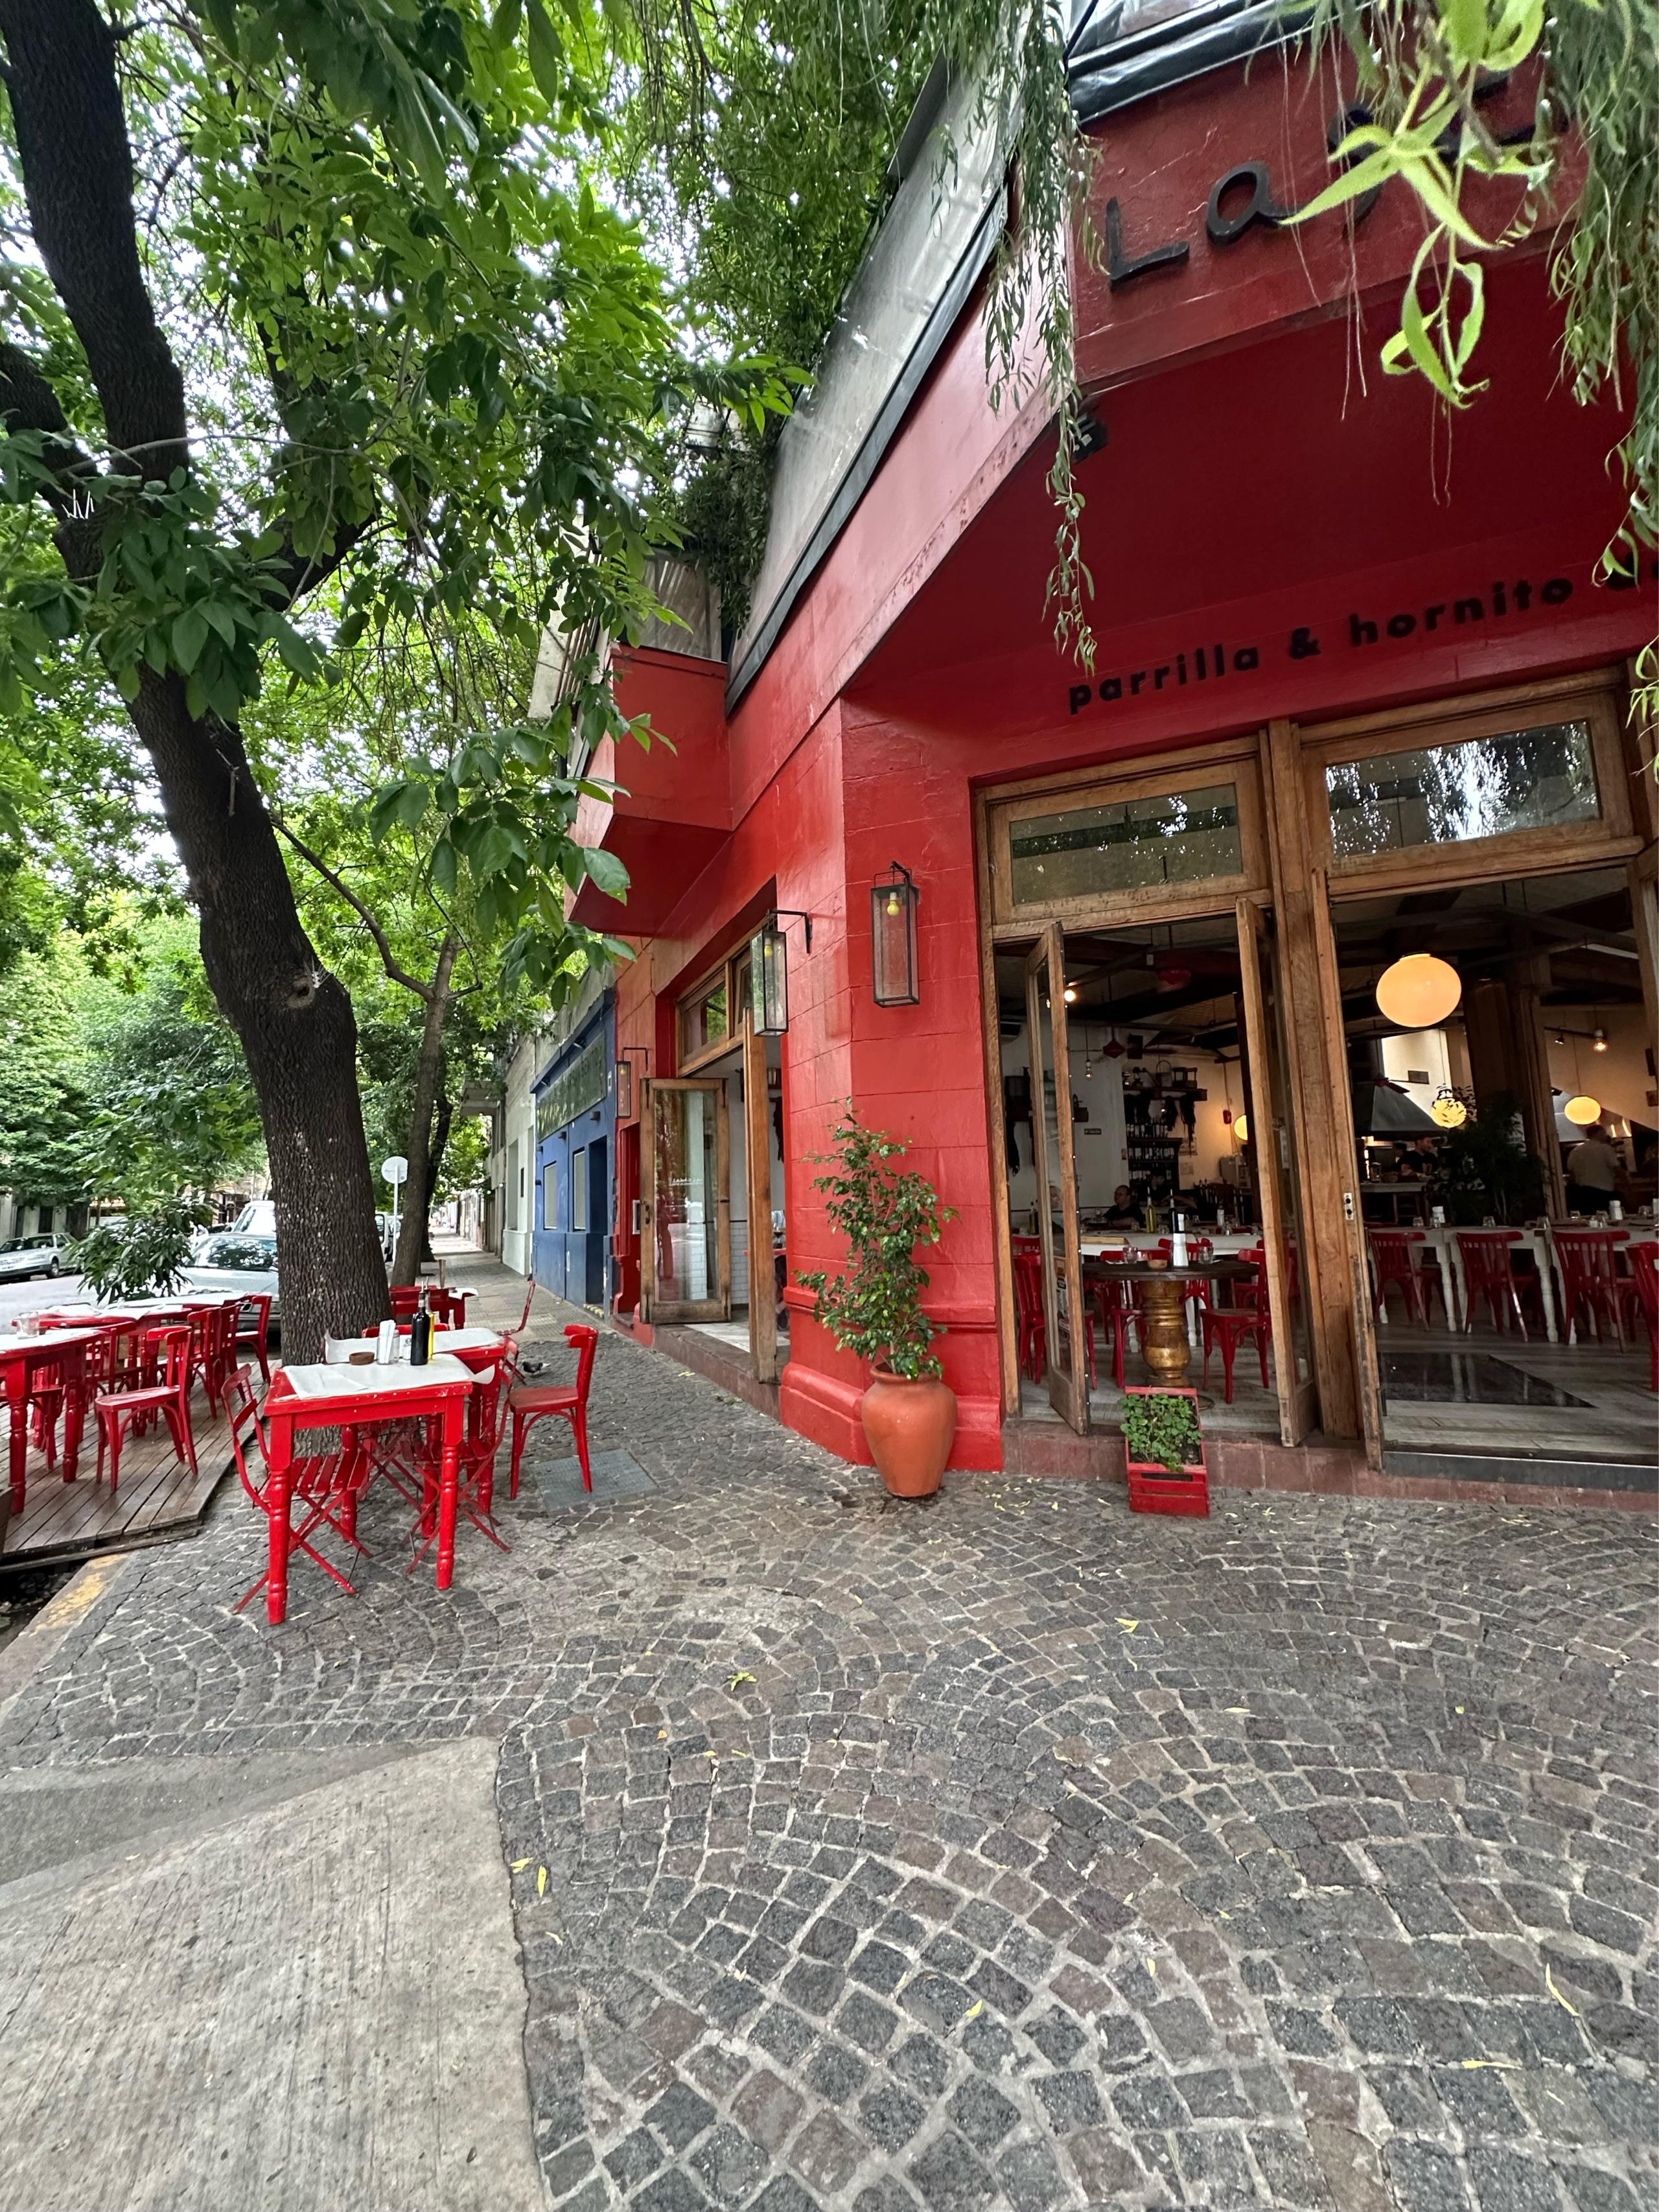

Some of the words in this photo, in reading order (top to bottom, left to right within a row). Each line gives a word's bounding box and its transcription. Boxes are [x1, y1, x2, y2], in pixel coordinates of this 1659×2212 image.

[1069, 644, 1259, 714] parrilla
[1290, 627, 1321, 660] &
[1350, 577, 1573, 647] hornito
